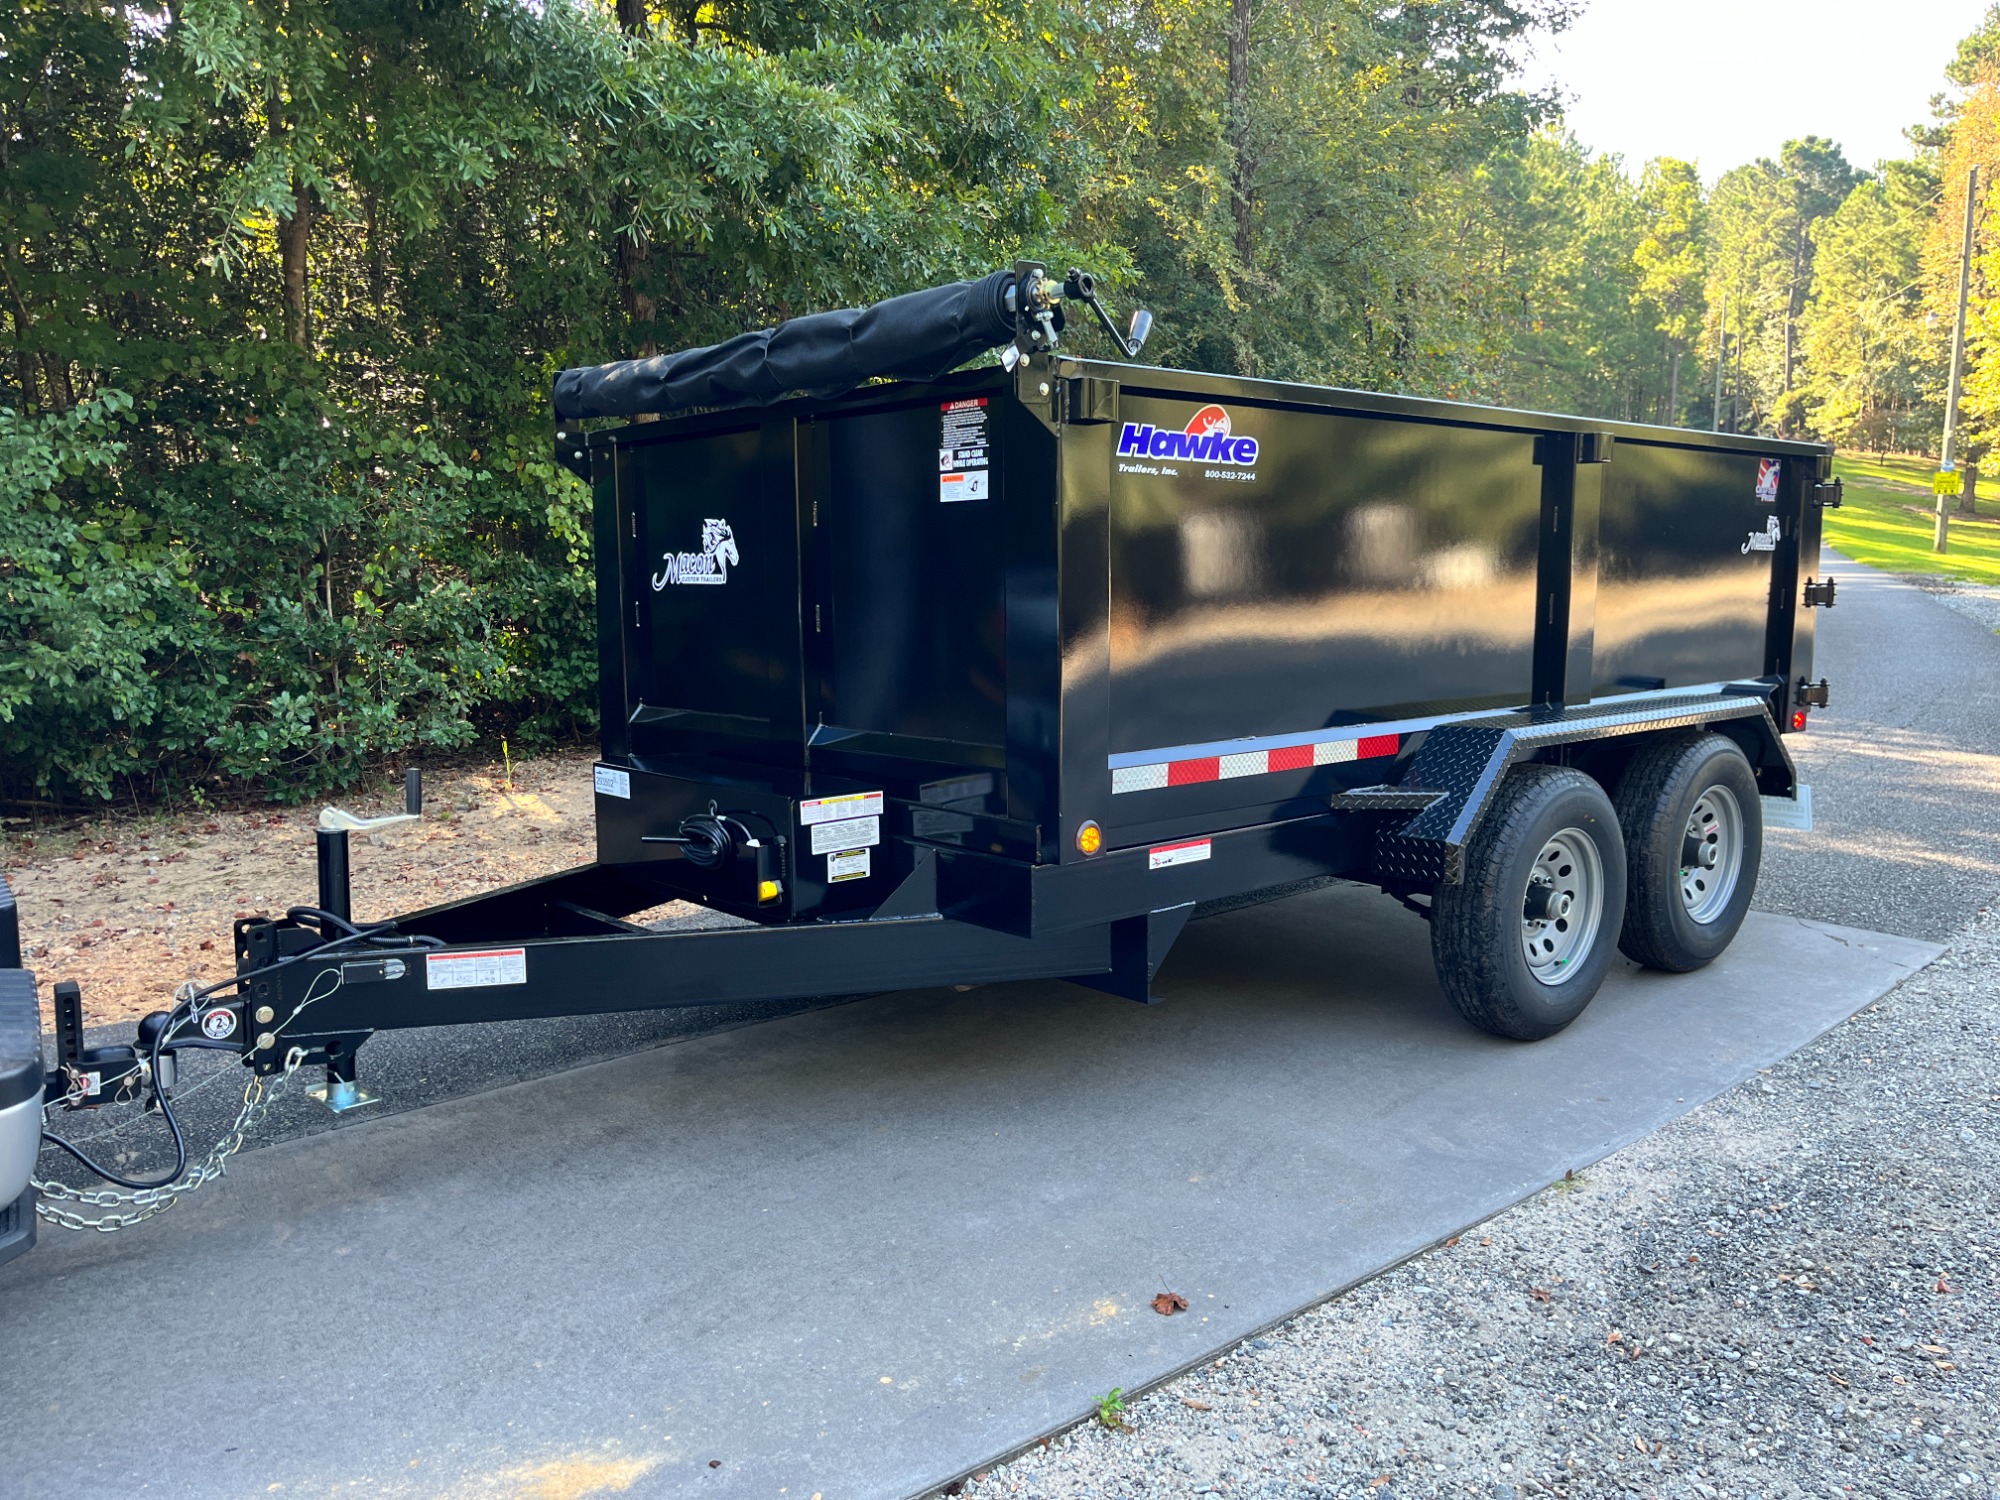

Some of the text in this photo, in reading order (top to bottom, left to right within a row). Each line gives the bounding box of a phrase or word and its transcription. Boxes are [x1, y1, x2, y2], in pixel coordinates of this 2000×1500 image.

[955, 399, 978, 409] DANGER
[1117, 422, 1259, 465] Hawke
[958, 449, 984, 459] STAND CLEAR
[1118, 463, 1178, 476] Trailers, Inc.
[1204, 469, 1256, 481] 800-532-7244
[652, 551, 716, 591] Macon
[215, 1017, 223, 1028] 2
